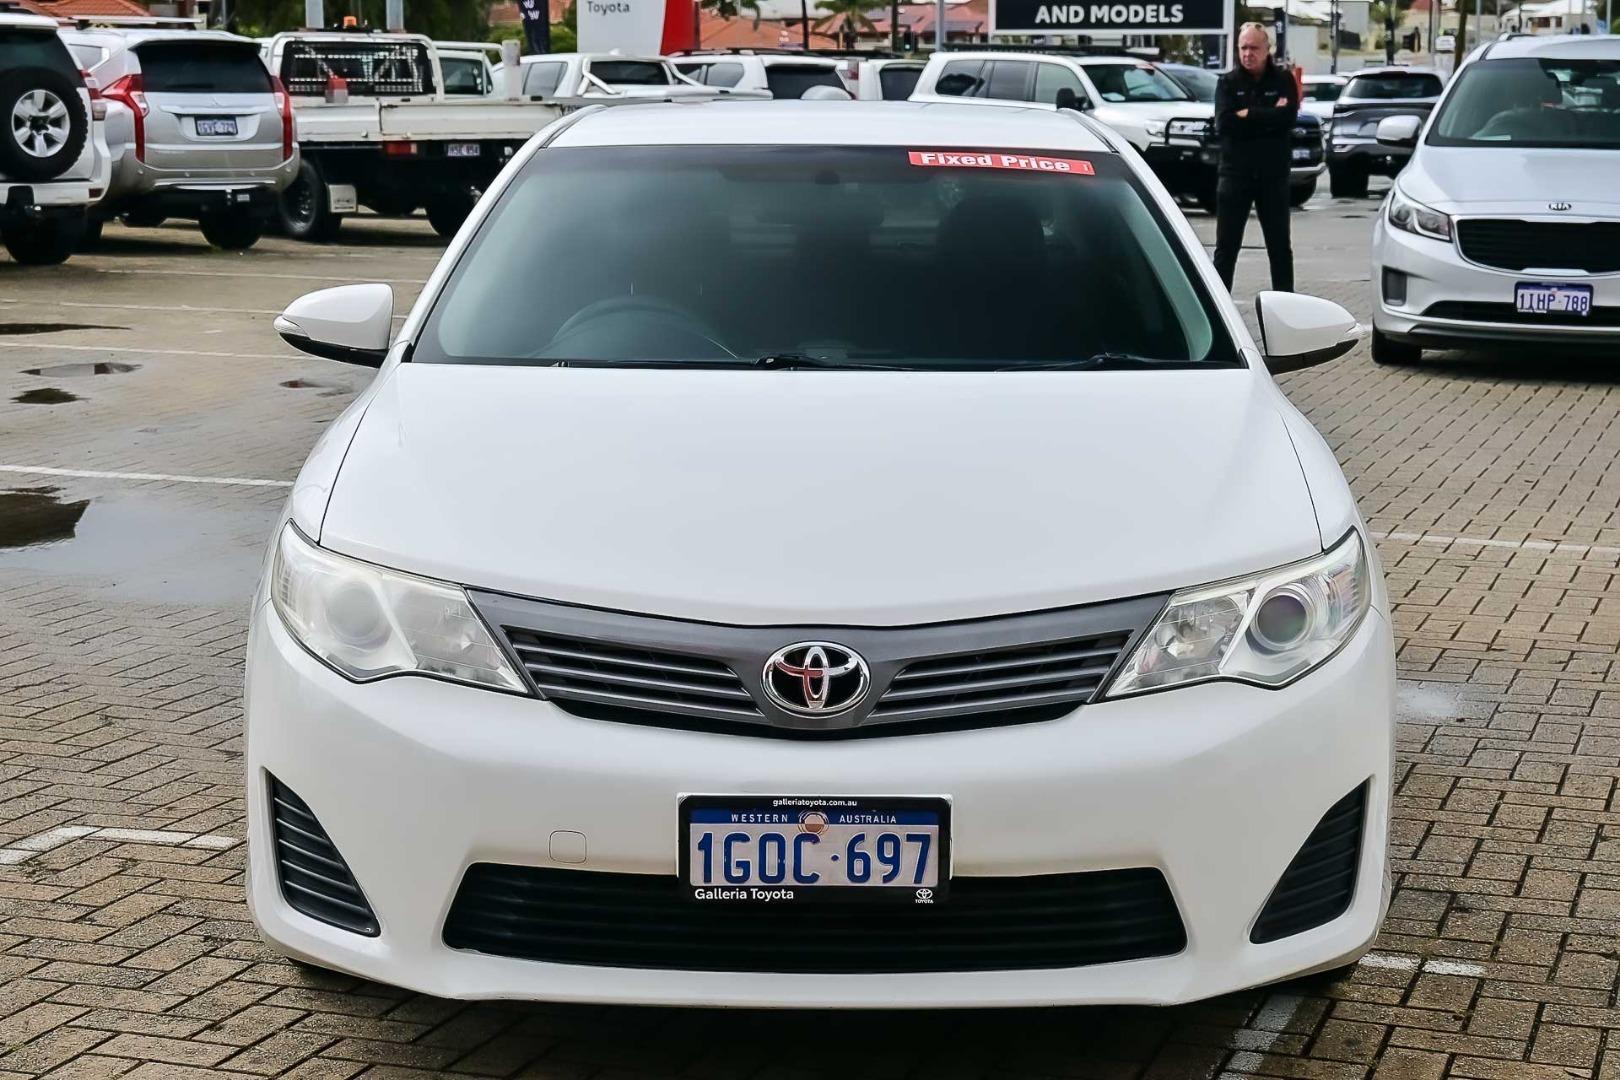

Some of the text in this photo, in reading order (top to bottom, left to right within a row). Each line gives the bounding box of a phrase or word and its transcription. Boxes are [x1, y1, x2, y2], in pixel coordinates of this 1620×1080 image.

[587, 0, 630, 16] Toyota
[1035, 4, 1184, 24] AND MODELS
[920, 152, 1071, 171] Fixed Price
[772, 798, 858, 807] galleriatoyota.com.au
[731, 813, 897, 824] WESTERN AUSTRALIA
[694, 888, 794, 902] Galleria Toyota
